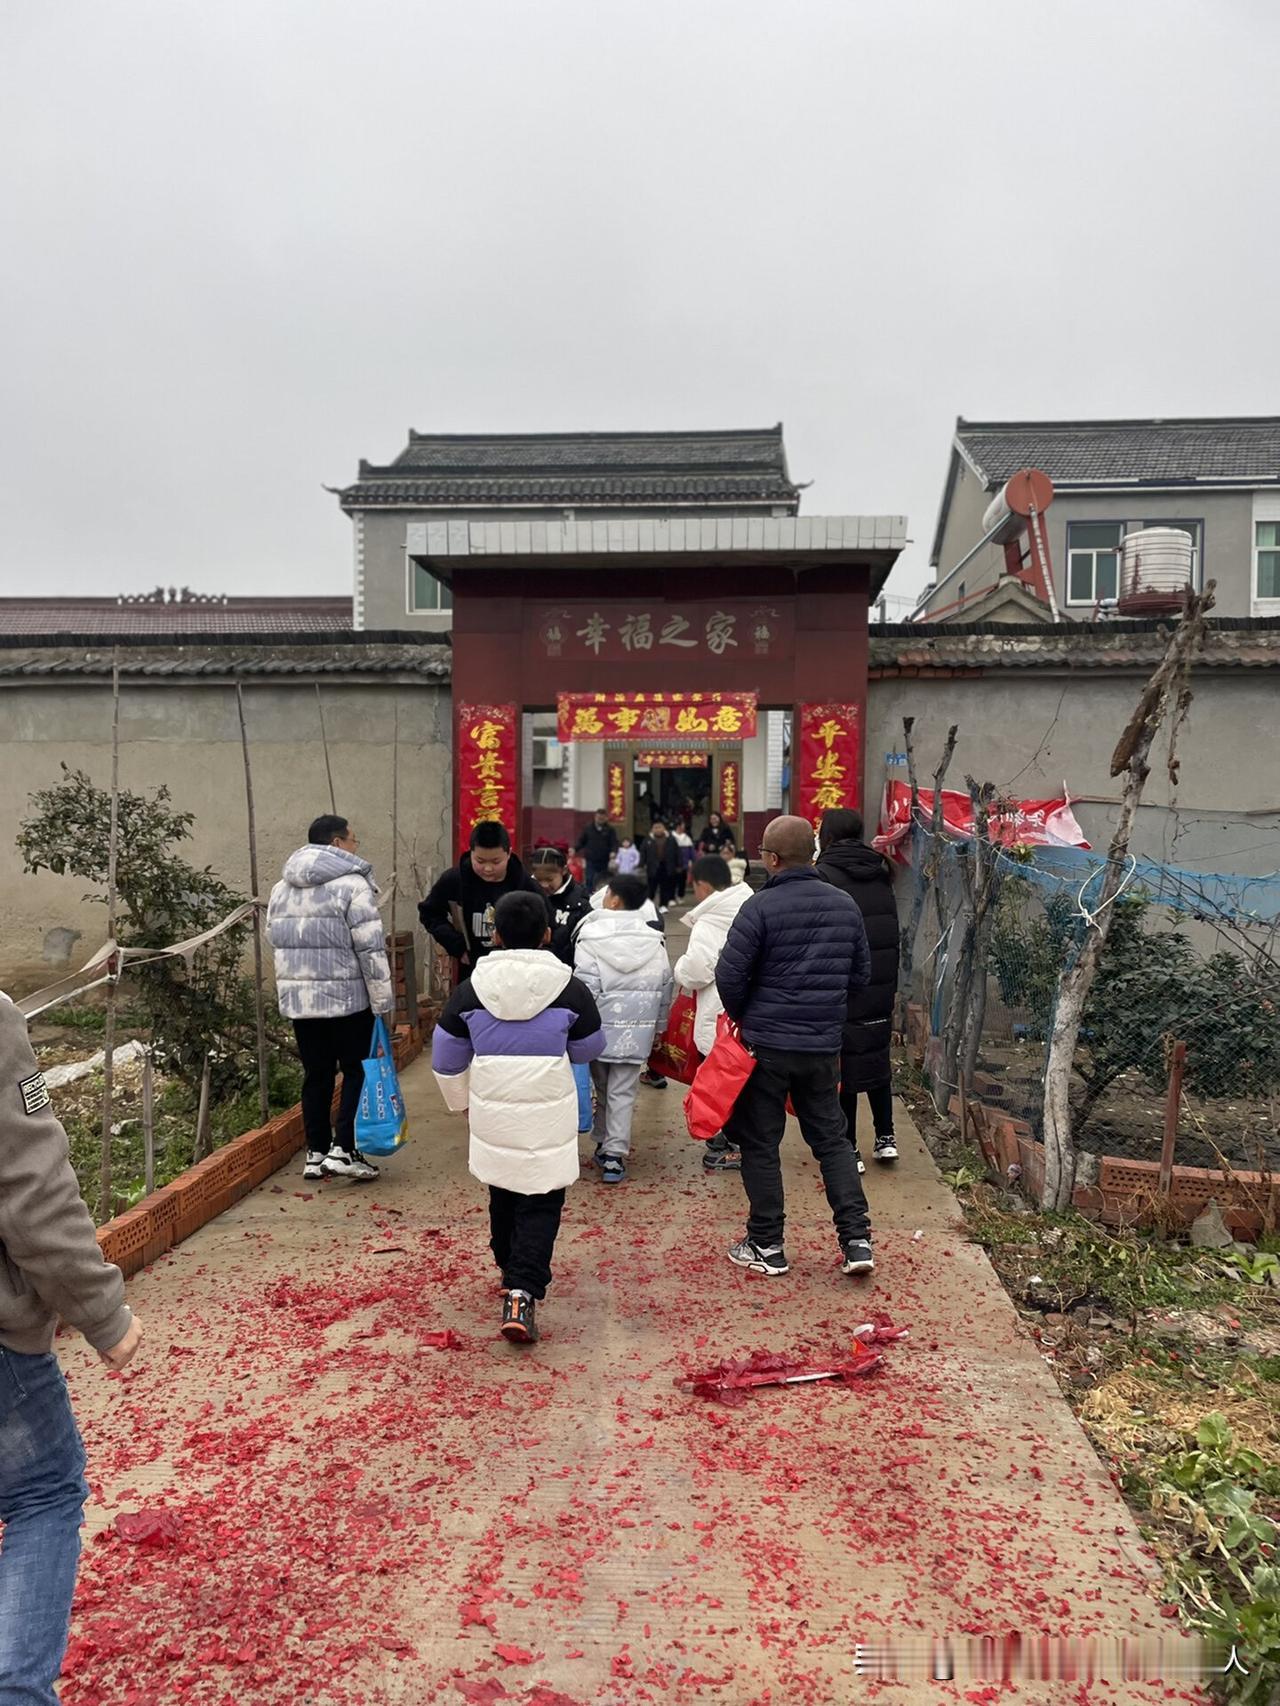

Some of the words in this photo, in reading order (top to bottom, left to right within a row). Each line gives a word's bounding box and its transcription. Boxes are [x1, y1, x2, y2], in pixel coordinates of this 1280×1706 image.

[576, 611, 738, 655] 幸福之家
[555, 909, 570, 925] M
